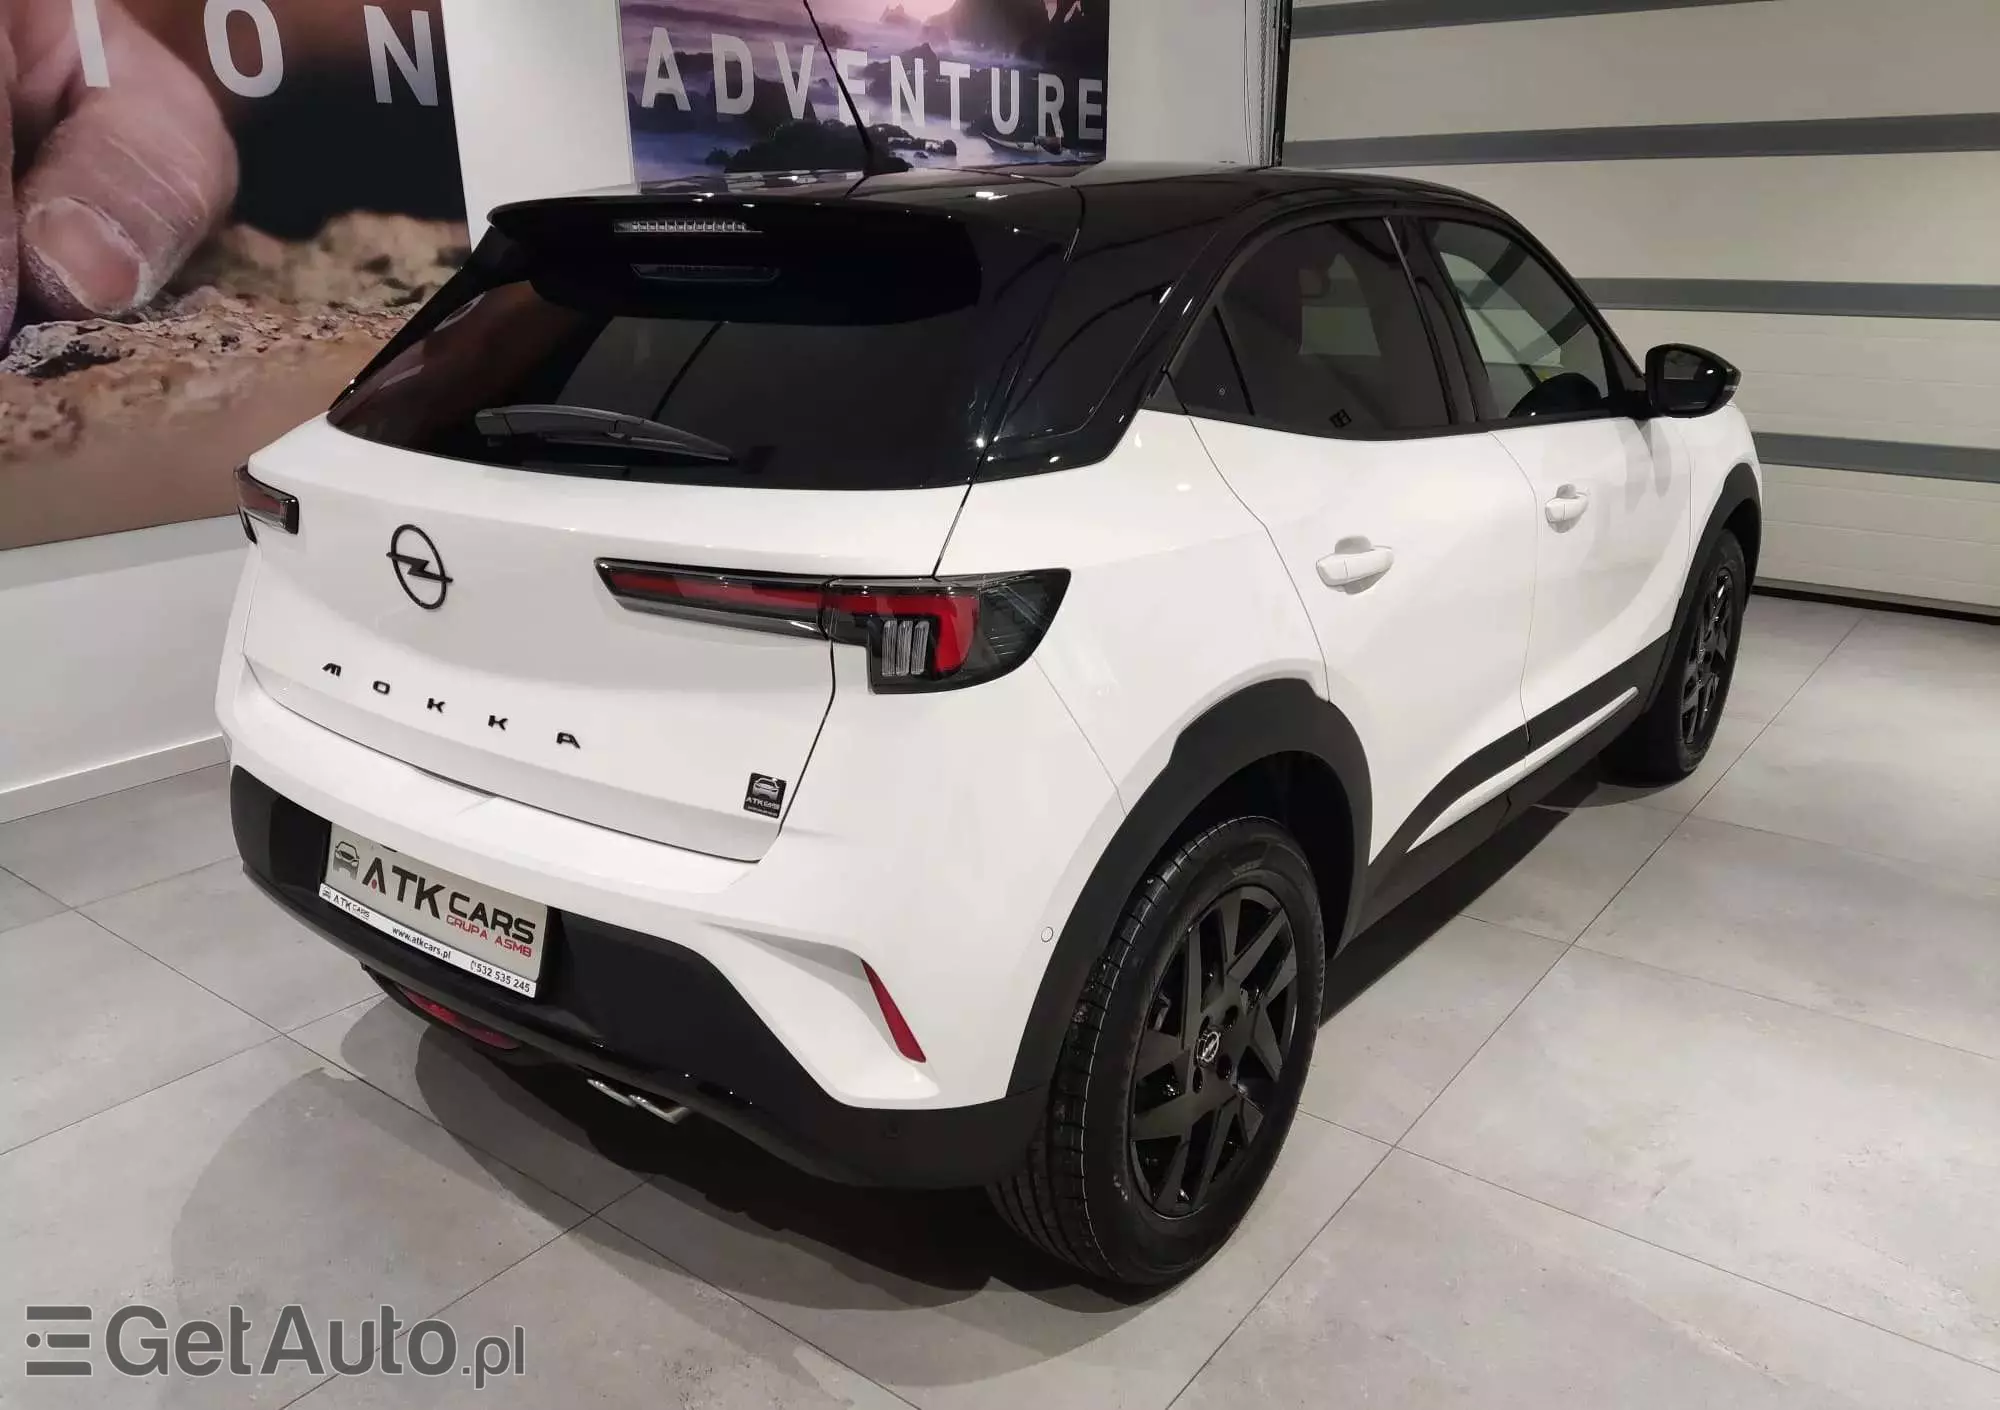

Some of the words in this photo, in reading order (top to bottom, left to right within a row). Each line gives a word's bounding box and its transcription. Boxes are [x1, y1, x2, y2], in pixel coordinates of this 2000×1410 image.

[641, 26, 1104, 141] ADVENTURE
[322, 662, 581, 749] MOKKA
[333, 895, 351, 911] ATK
[361, 857, 446, 919] ATK
[448, 891, 536, 945] CARS
[392, 926, 451, 960] www.atkcars.pl
[446, 914, 488, 940] GRUPA
[494, 936, 532, 958] ASMB
[477, 963, 493, 977] 532
[495, 971, 511, 985] 535
[513, 978, 530, 993] 245
